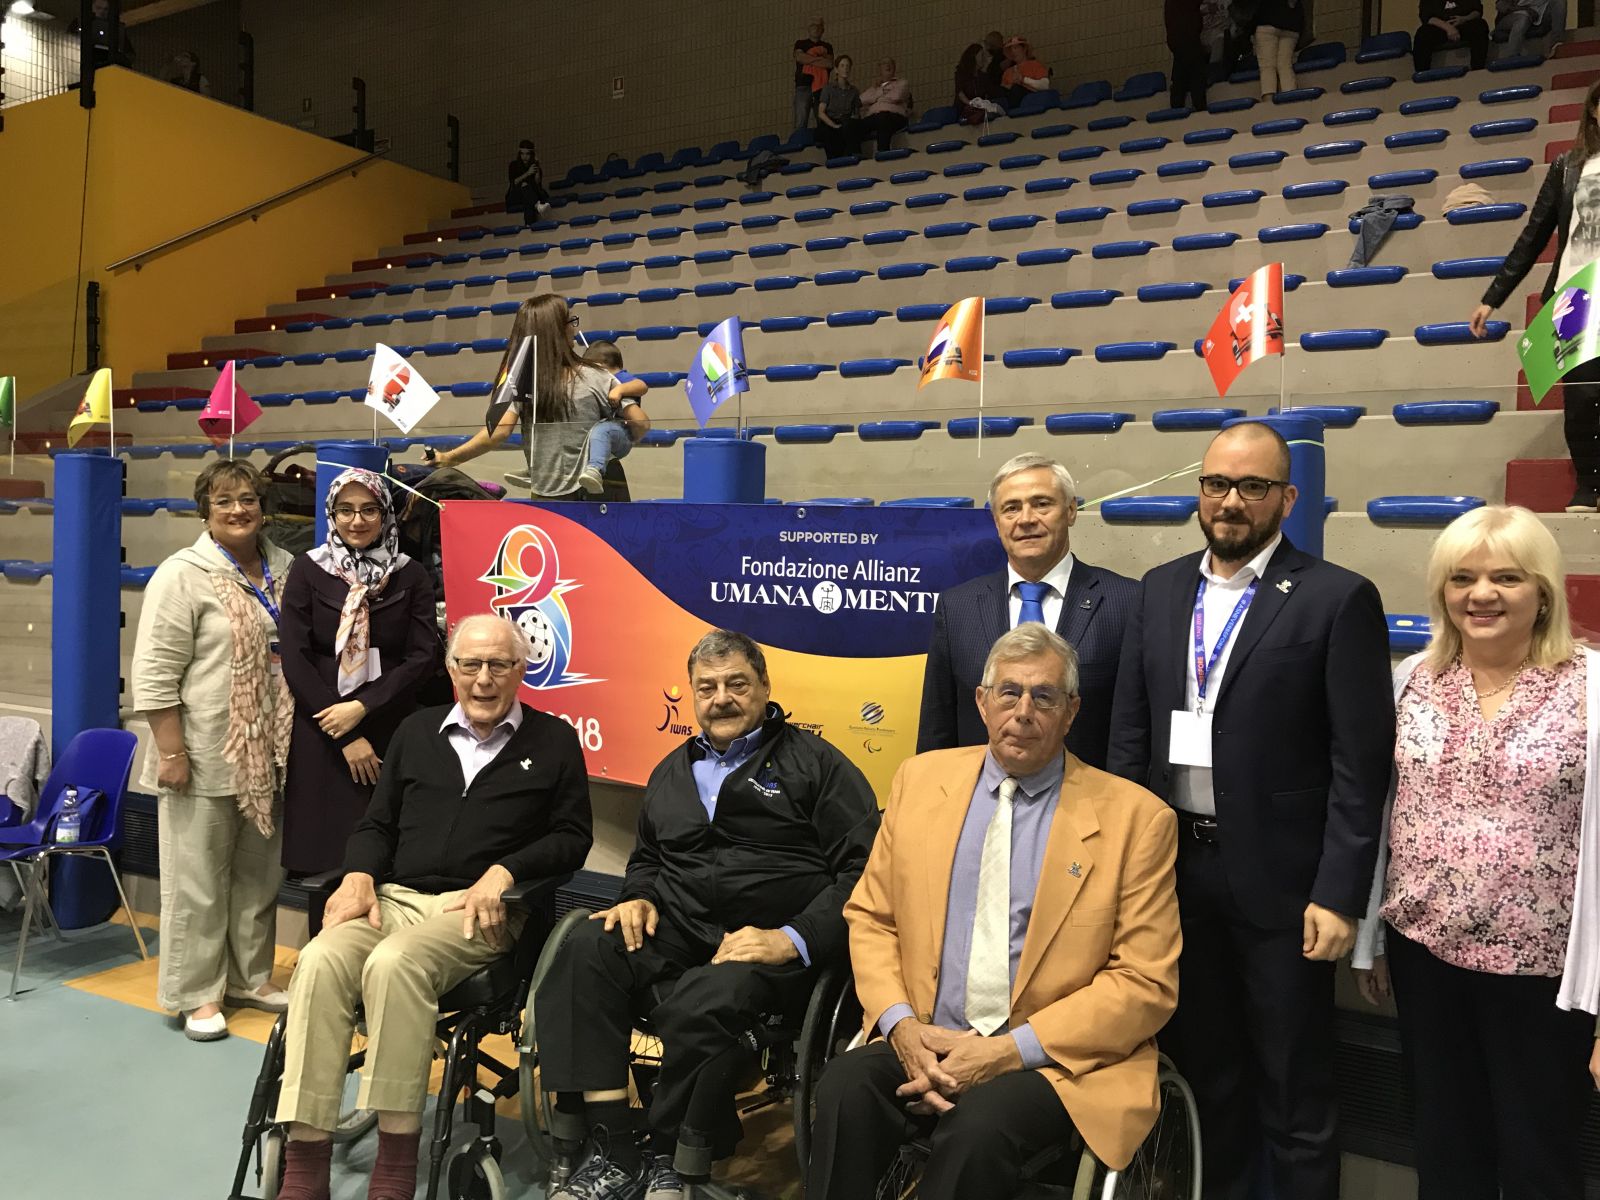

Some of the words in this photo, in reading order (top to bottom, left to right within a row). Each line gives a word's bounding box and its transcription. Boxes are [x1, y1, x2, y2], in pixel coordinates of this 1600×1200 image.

[779, 531, 858, 544] SUPPORTED
[860, 533, 879, 545] BY
[741, 555, 849, 580] Fondazione
[853, 559, 921, 583] Allianz
[710, 581, 812, 607] UMANA
[669, 724, 693, 736] IWAS
